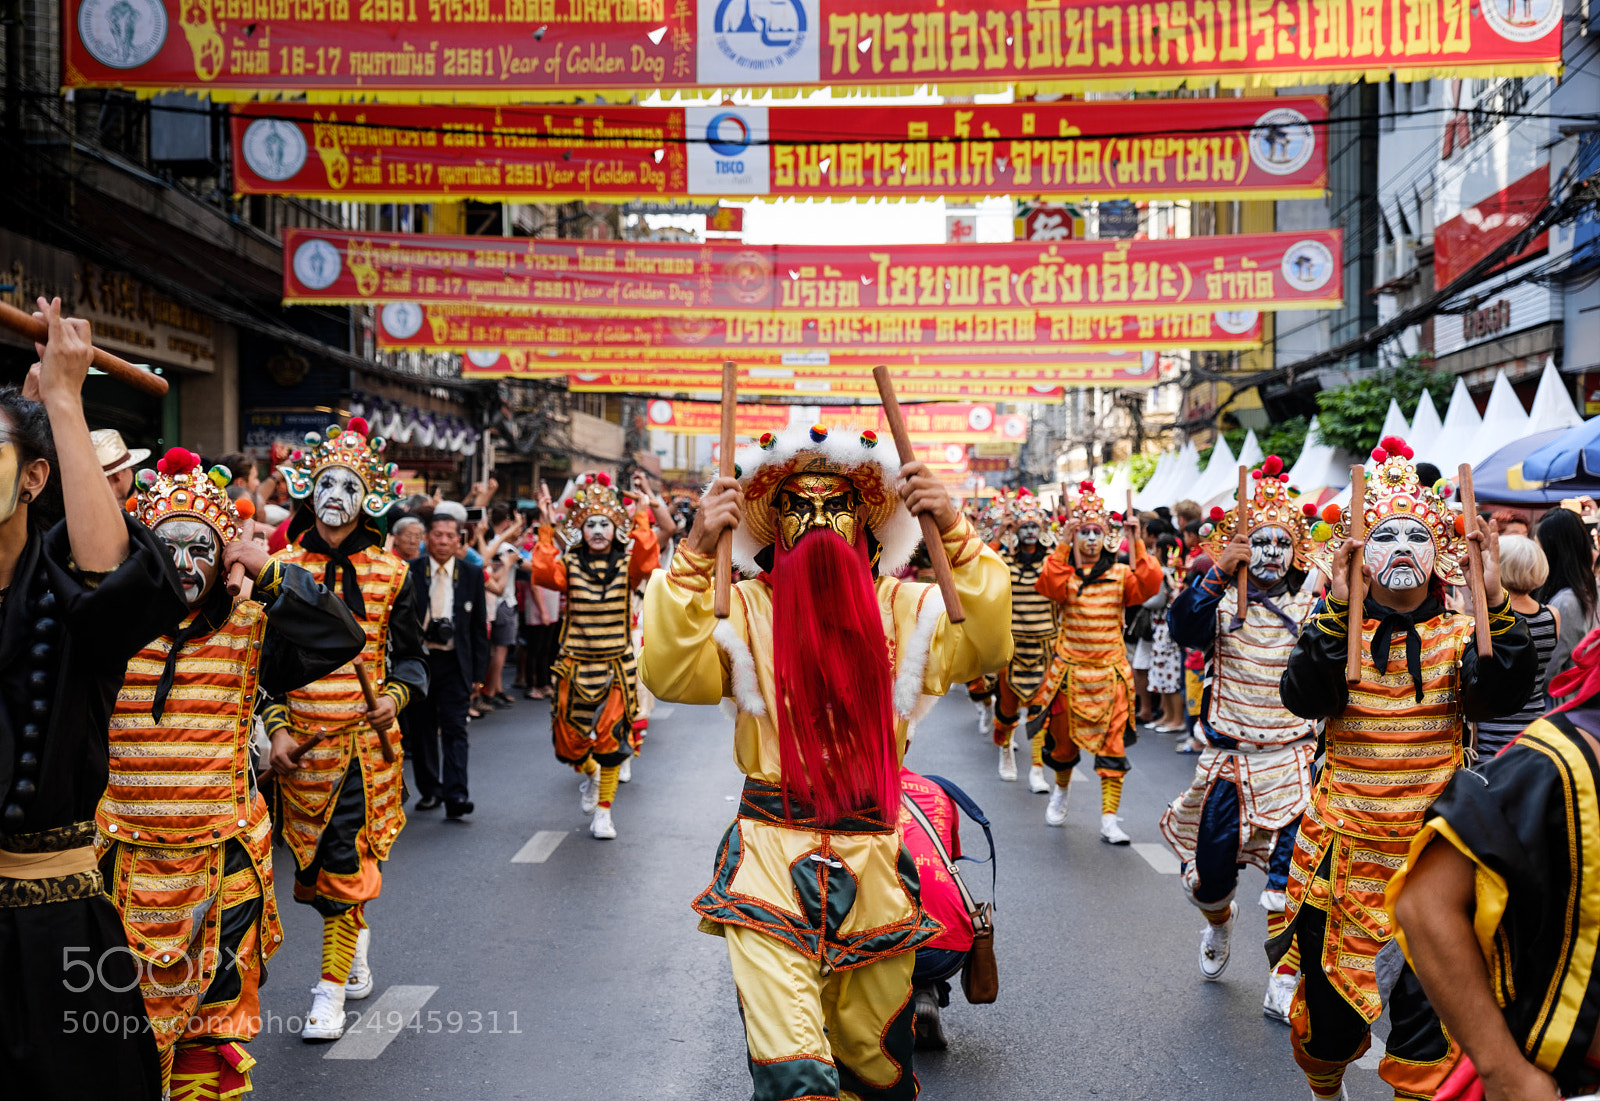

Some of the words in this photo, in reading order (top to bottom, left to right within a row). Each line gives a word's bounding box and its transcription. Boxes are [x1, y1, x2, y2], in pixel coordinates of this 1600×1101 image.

[359, 0, 418, 22] 2561
[230, 26, 270, 75] วันที่
[349, 41, 440, 86] กุมภาพันธ์
[442, 47, 495, 77] 2561
[498, 44, 540, 81] Year
[544, 42, 563, 84] of
[565, 42, 626, 74] Golden
[629, 44, 666, 83] Dog
[544, 161, 575, 189] Year
[577, 159, 592, 192] of
[593, 161, 636, 185] Golden
[639, 161, 666, 192] Dog
[573, 280, 602, 302] Year
[606, 279, 621, 304] of
[622, 281, 665, 300] Golden
[781, 265, 860, 307] บริษัท
[1204, 256, 1275, 300] จำกัด
